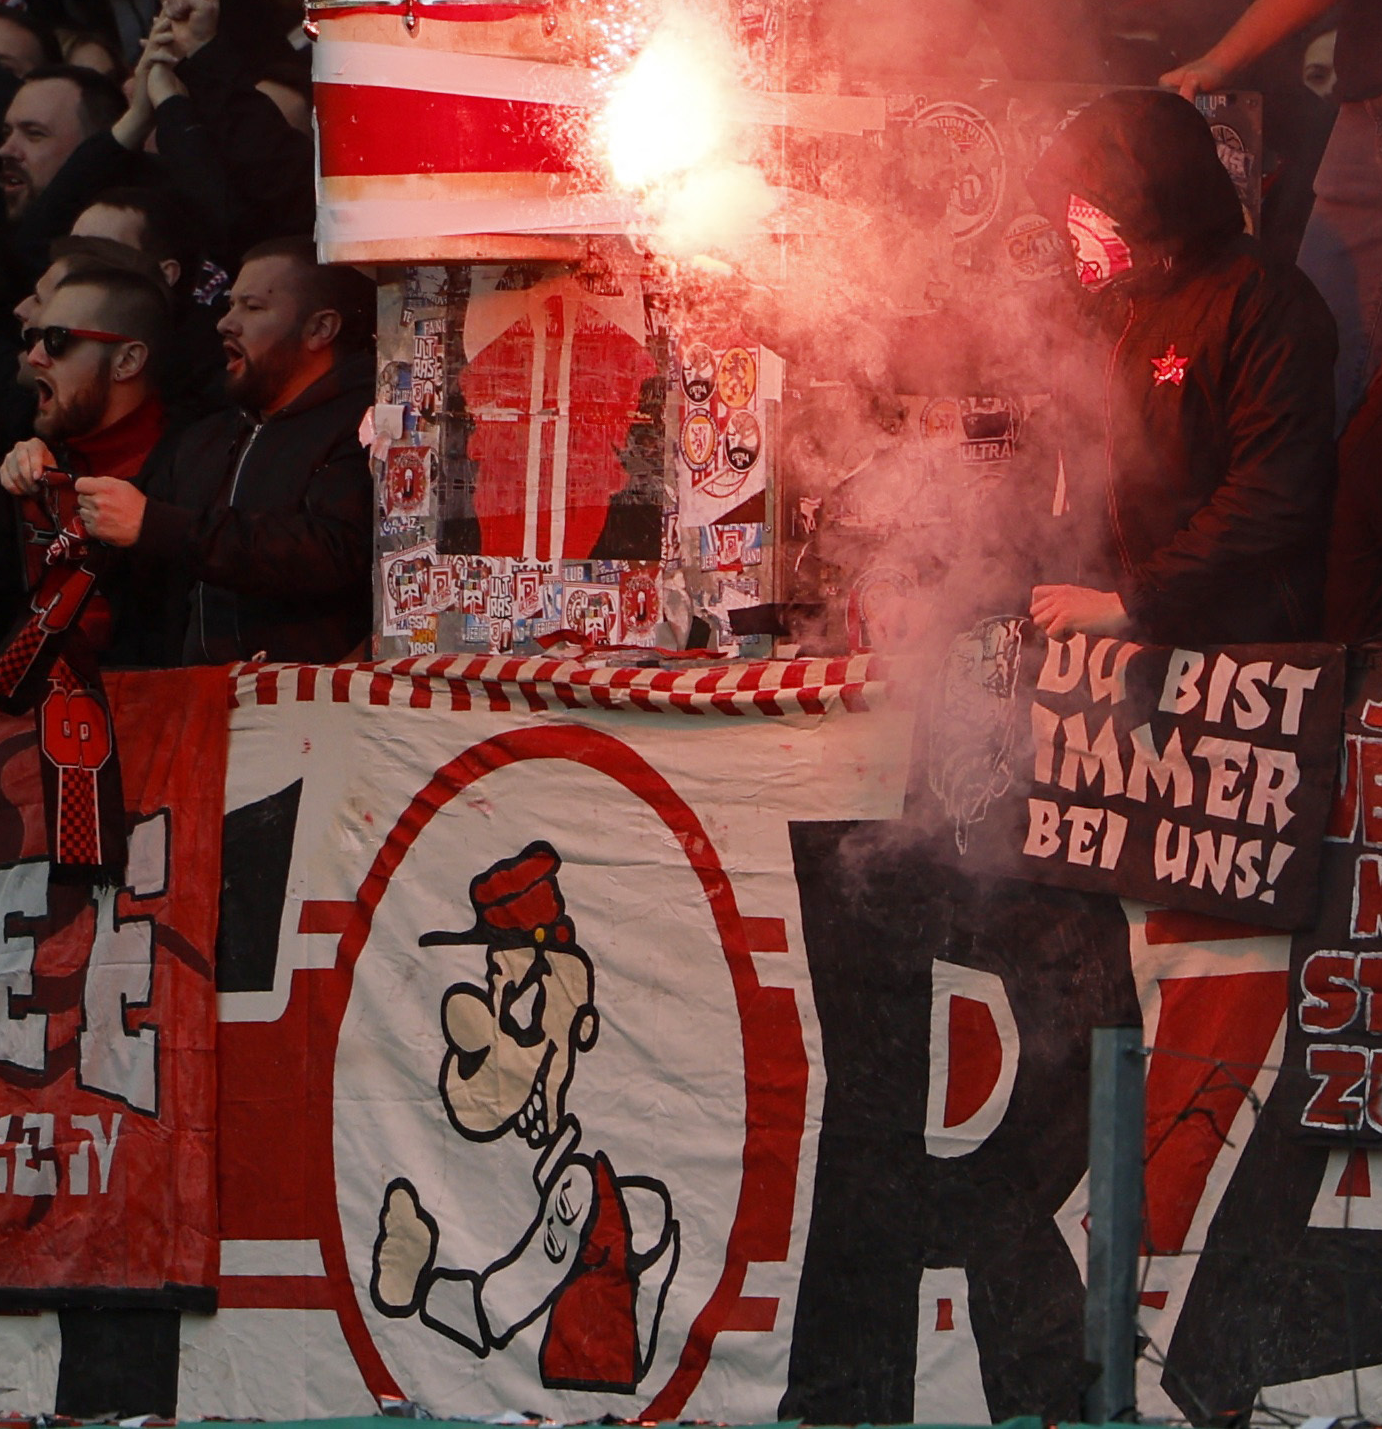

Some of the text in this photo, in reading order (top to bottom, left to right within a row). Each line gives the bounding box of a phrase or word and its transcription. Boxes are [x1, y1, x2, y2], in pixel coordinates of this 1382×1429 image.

[490, 575, 511, 598] ULT
[490, 596, 512, 618] RAS
[1035, 631, 1321, 735] DU BIST
[1029, 703, 1301, 833] IMMER
[1021, 801, 1294, 904] BEI UNS!
